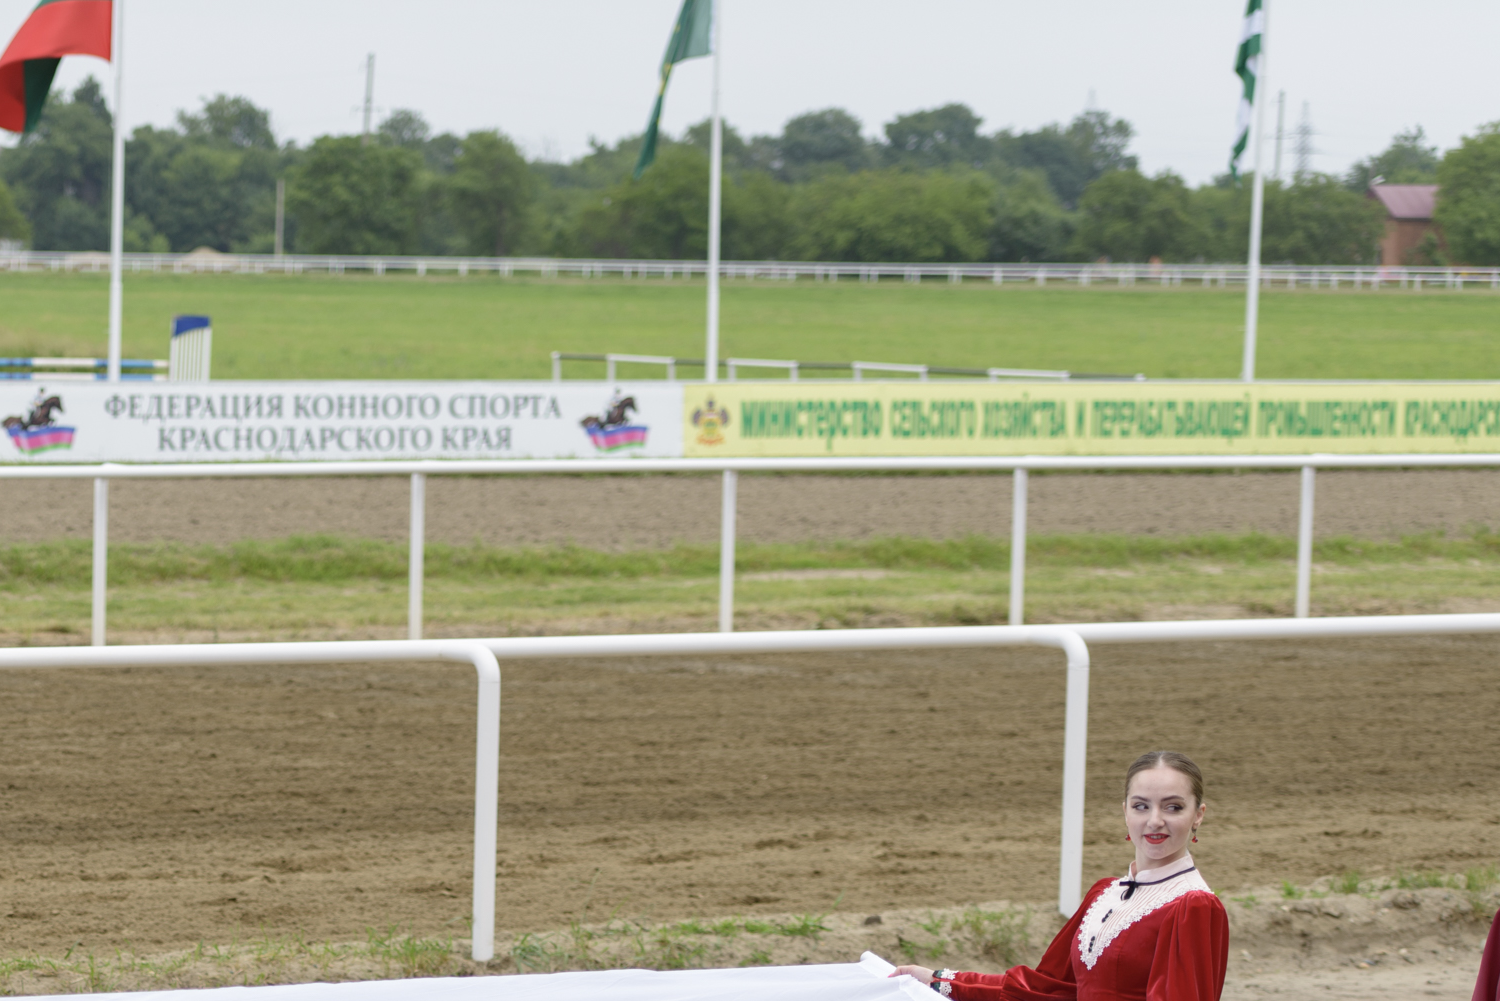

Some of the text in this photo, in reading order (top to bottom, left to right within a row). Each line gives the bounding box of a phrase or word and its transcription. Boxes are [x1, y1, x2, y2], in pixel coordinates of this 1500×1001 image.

[104, 395, 562, 424] ФЕДЕРАЦИЯ КОННОГО СПОРТА
[157, 427, 512, 453] КРАСНОДАРСКОГО КРАЯ
